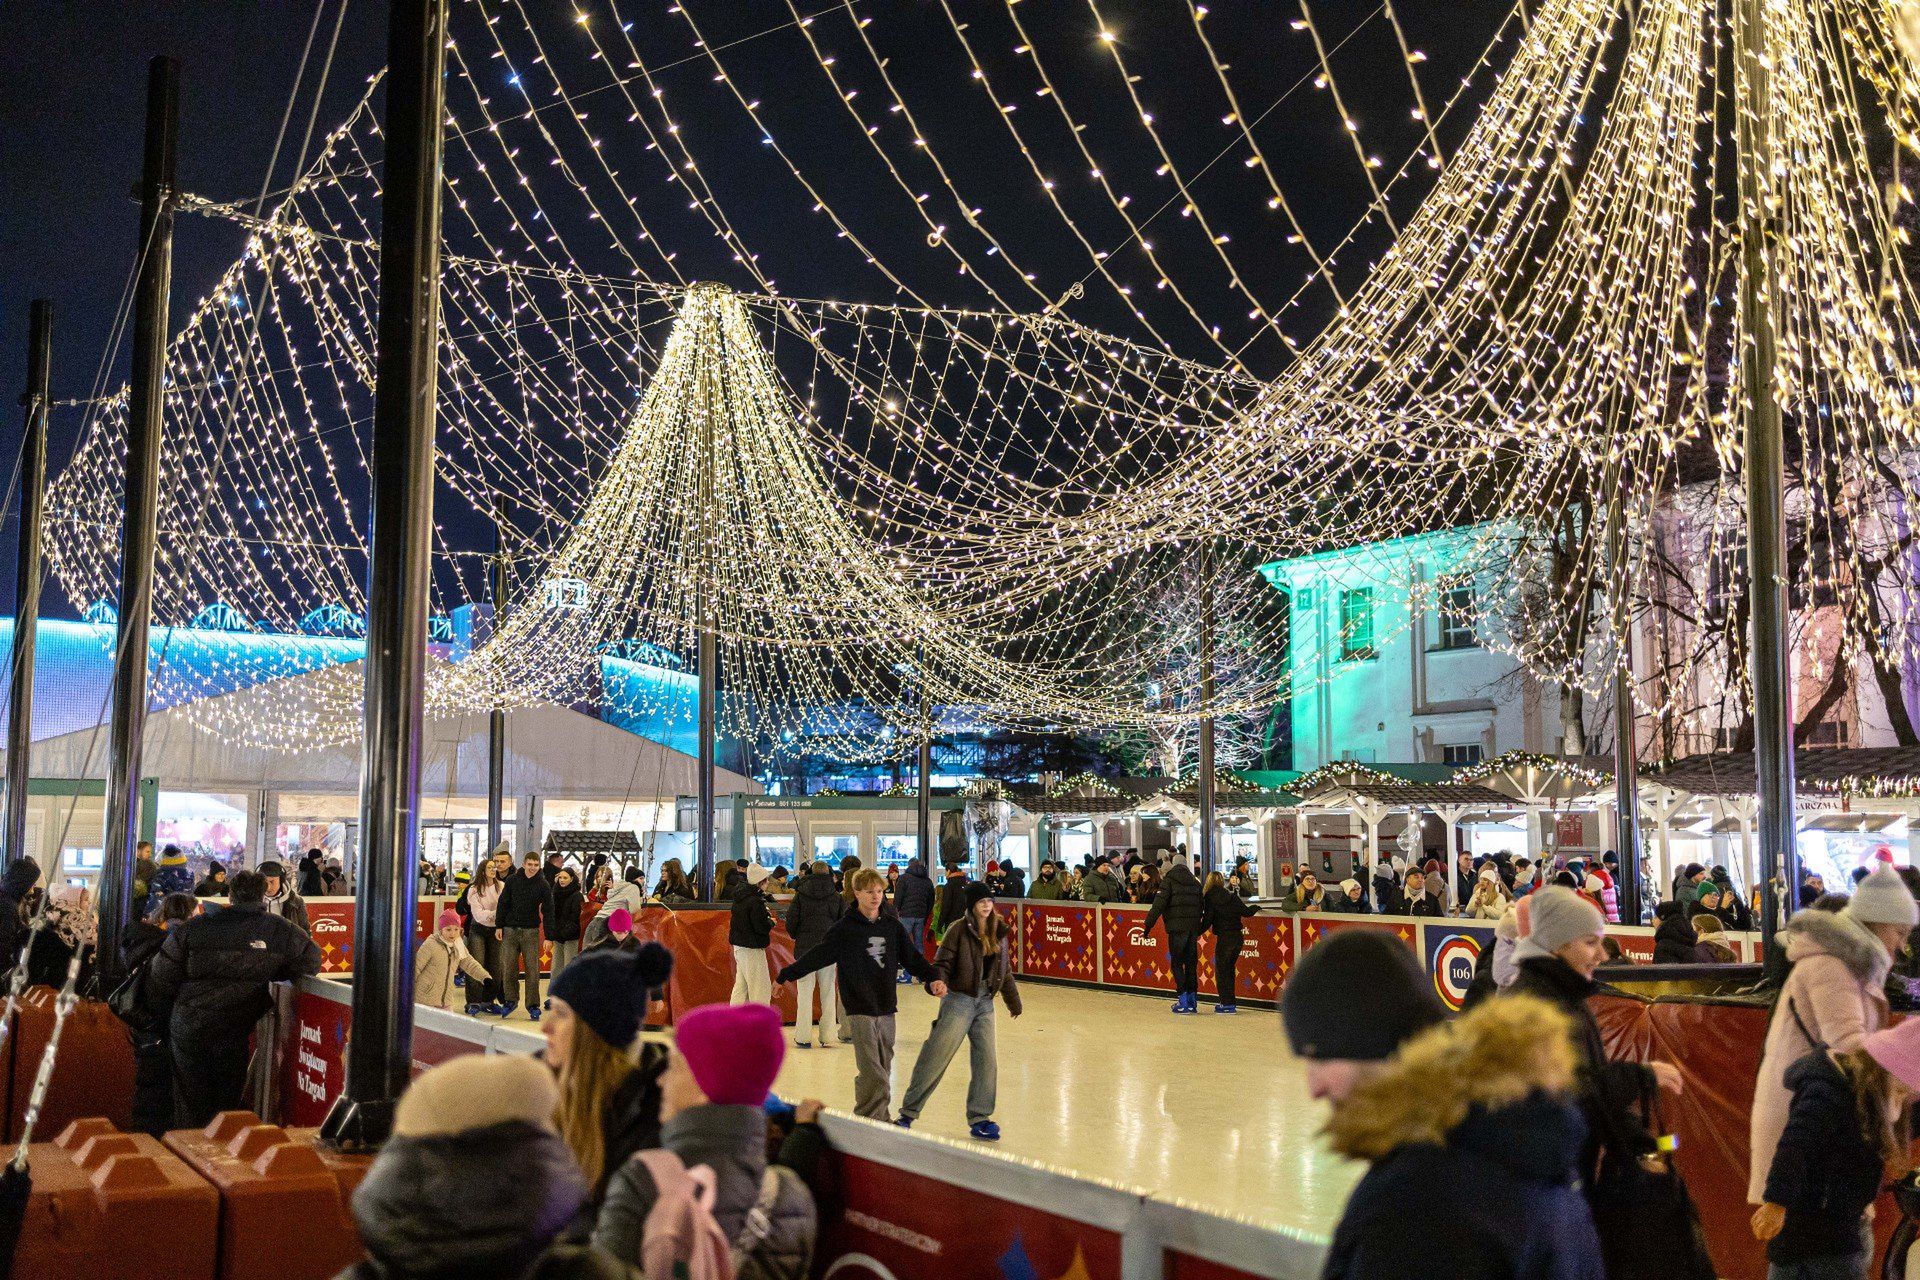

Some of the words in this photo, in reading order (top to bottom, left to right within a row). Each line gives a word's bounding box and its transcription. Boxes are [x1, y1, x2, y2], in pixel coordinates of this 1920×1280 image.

[1046, 914, 1065, 923] Jarmark
[316, 923, 348, 932] Enea
[1046, 923, 1072, 935] Świąteczny
[1053, 934, 1072, 944] Targach
[1130, 933, 1157, 947] Enea
[1238, 949, 1260, 959] argach
[1625, 948, 1654, 961] Jarma
[1452, 966, 1471, 980] 106
[300, 1019, 322, 1045] Jarmark
[297, 1070, 305, 1091] Na
[305, 1074, 327, 1103] Targach
